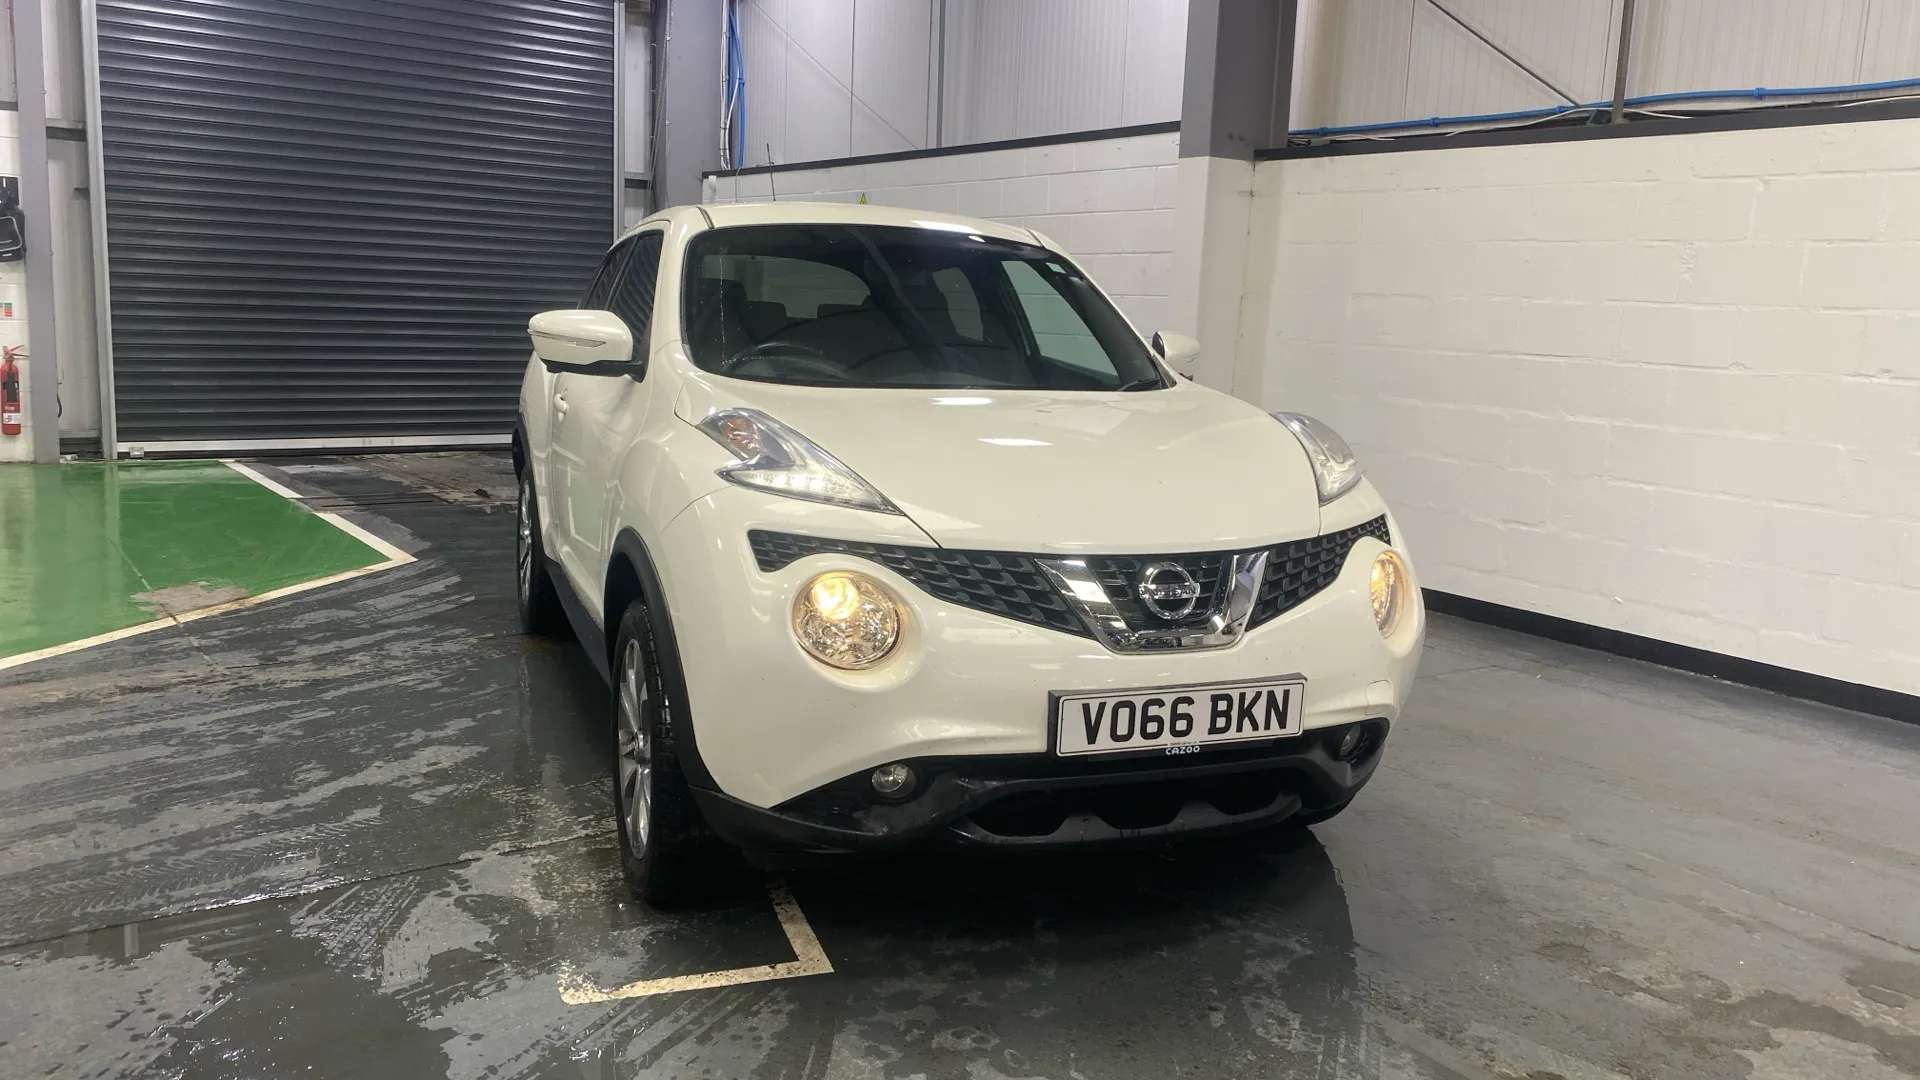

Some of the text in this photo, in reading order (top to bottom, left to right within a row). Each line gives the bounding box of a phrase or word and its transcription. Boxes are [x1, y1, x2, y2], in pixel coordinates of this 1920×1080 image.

[1082, 689, 1290, 745] VO66 BKN
[1165, 745, 1200, 755] CAZOO
